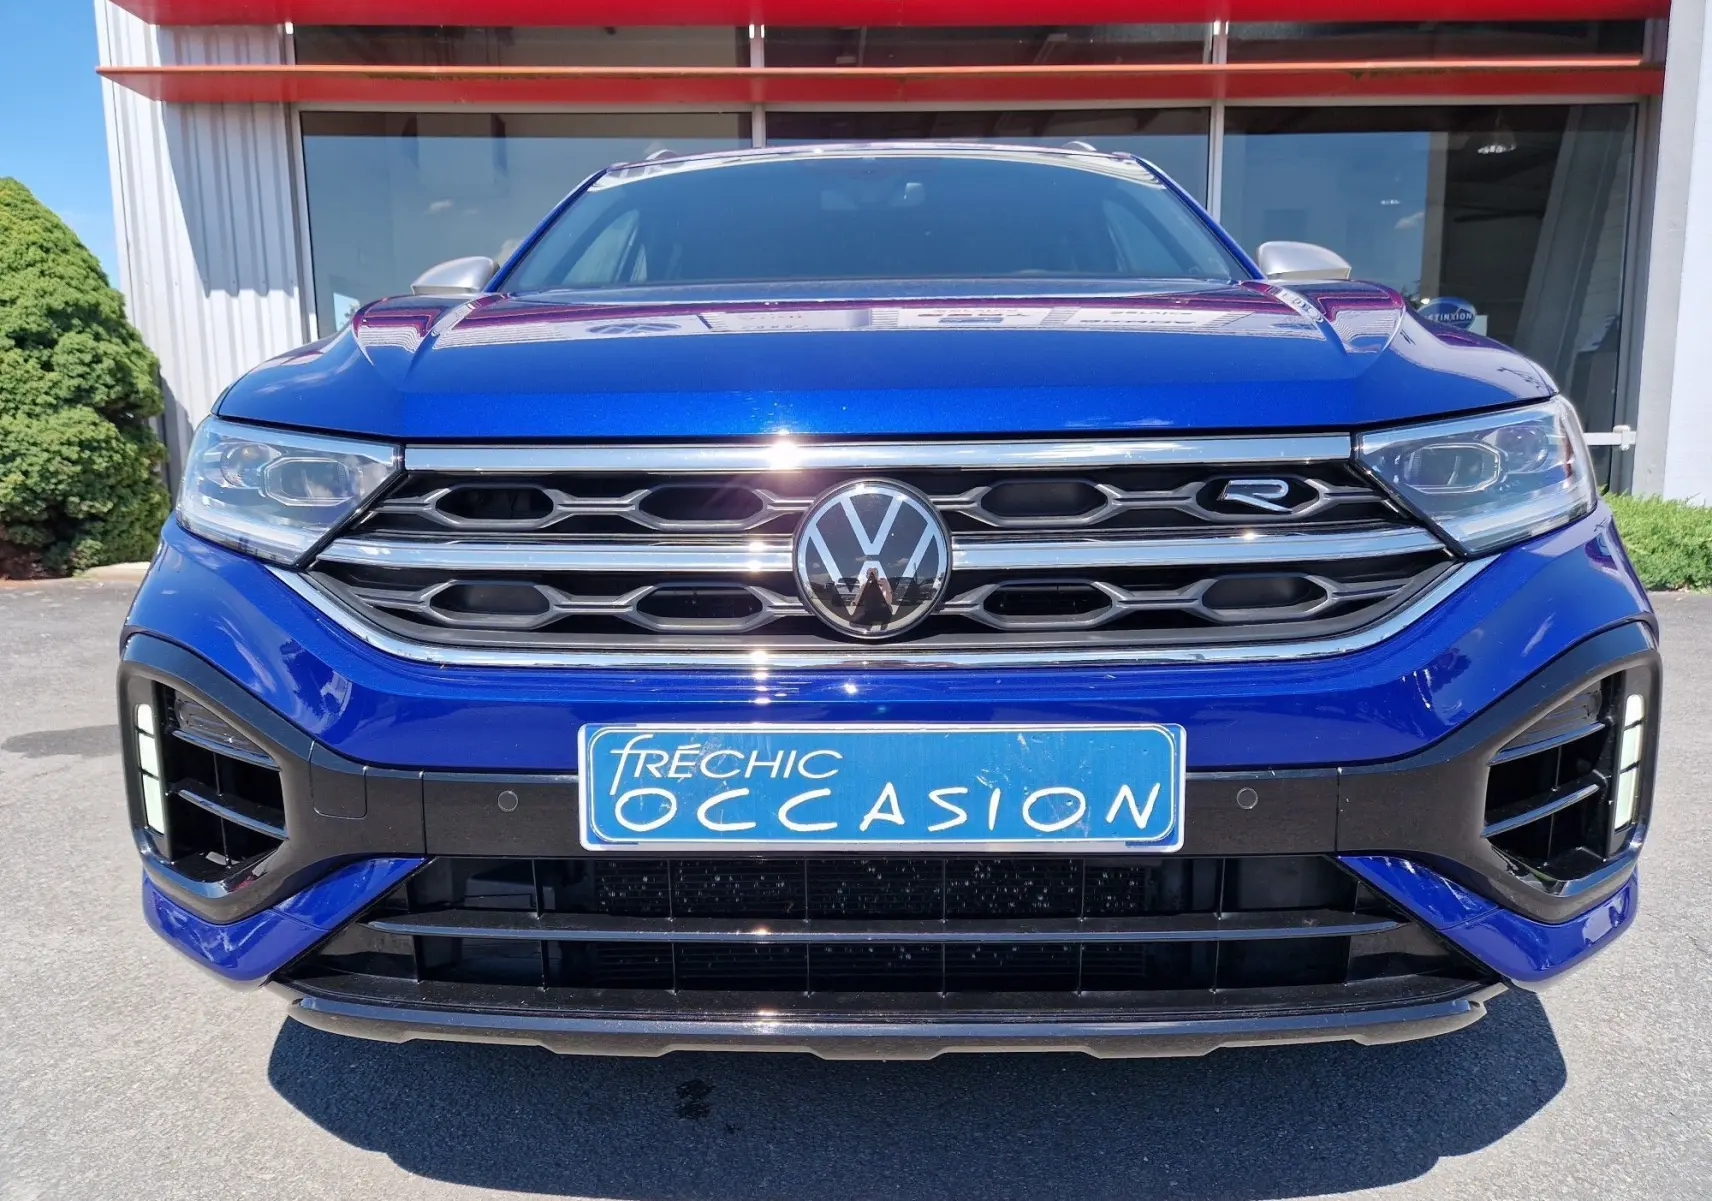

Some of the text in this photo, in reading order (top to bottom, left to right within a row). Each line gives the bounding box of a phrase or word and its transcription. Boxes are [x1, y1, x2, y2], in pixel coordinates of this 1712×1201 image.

[1424, 312, 1472, 321] STINXION
[1217, 479, 1293, 514] R
[799, 486, 947, 633] VW
[614, 782, 1161, 833] OCCASION
